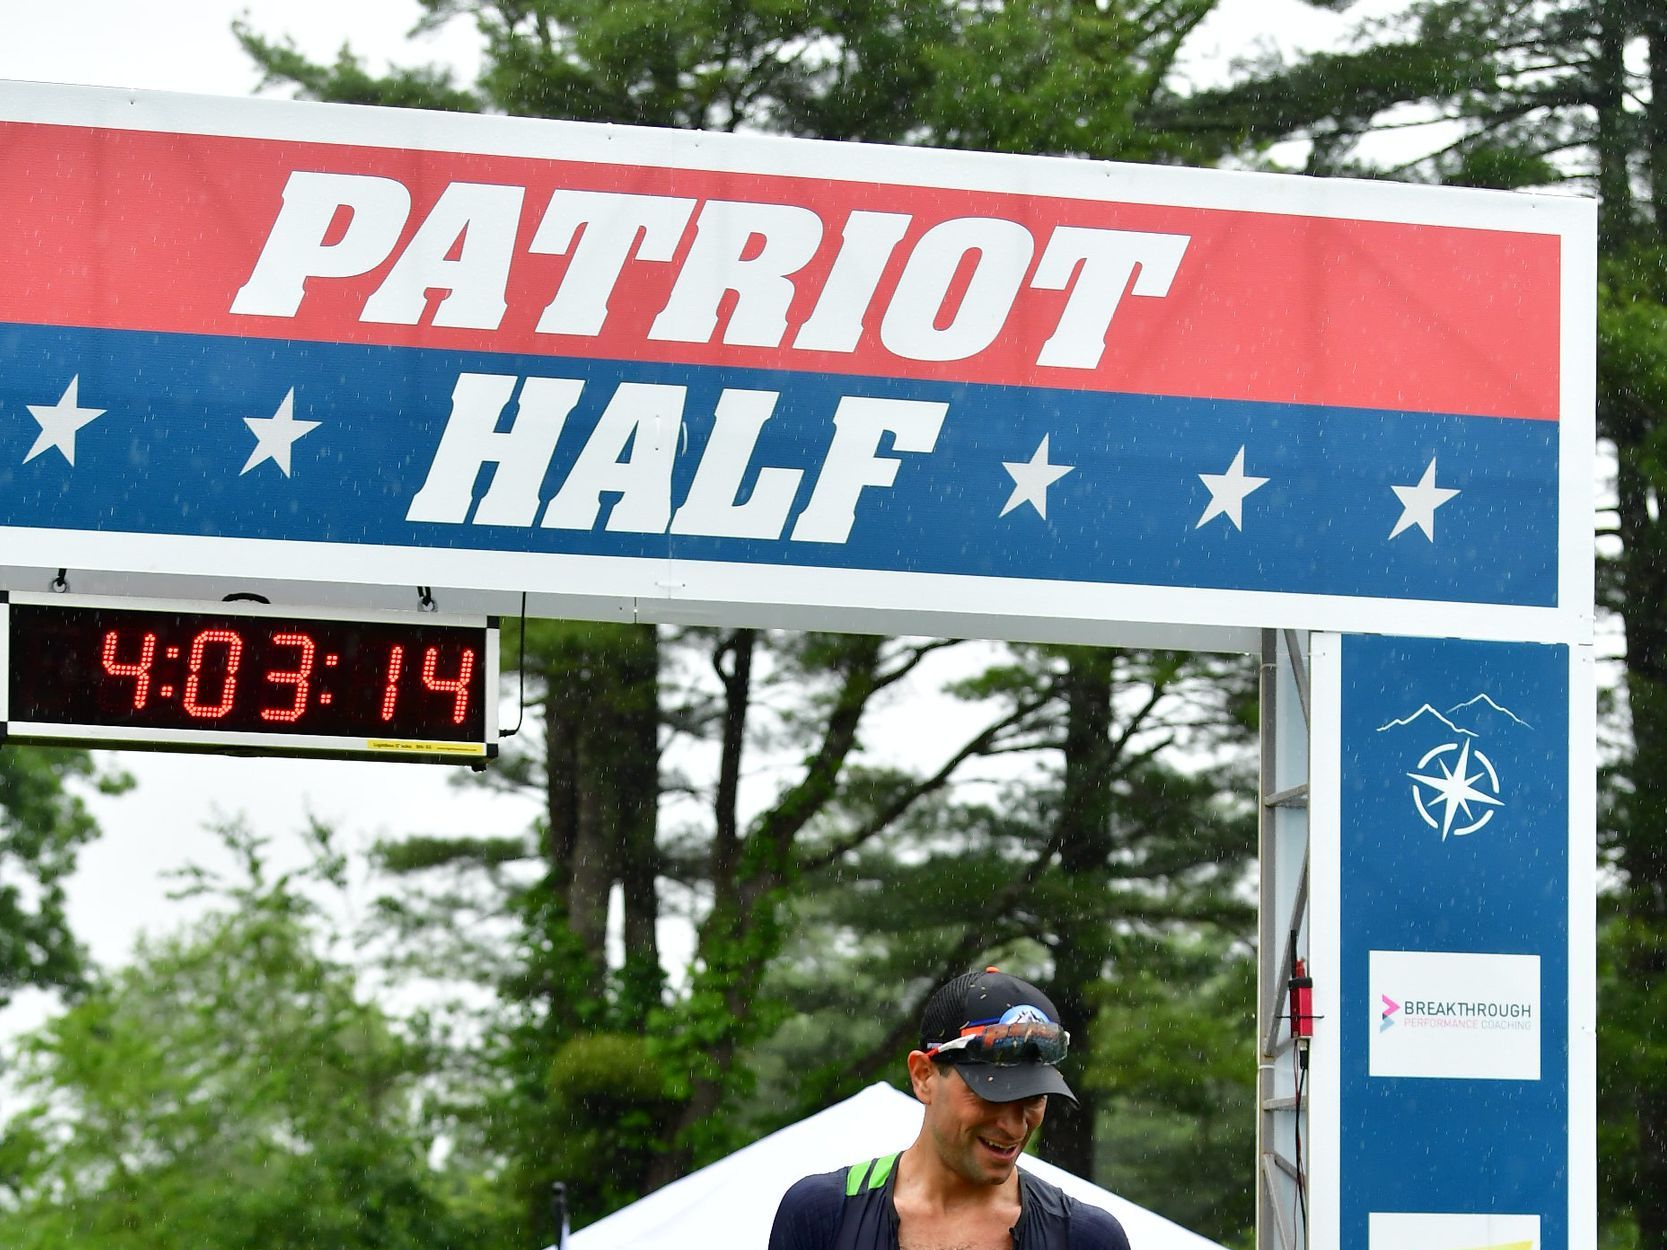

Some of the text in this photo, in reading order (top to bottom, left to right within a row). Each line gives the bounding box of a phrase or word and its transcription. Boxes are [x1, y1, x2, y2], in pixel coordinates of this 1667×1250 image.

[230, 170, 1190, 369] PATRIOT
[405, 372, 949, 545] HALF
[102, 631, 475, 725] 4:03:14
[1404, 1000, 1532, 1018] BREAKTHROUGH
[1404, 1018, 1532, 1031] PERFORMANCE COACHING
